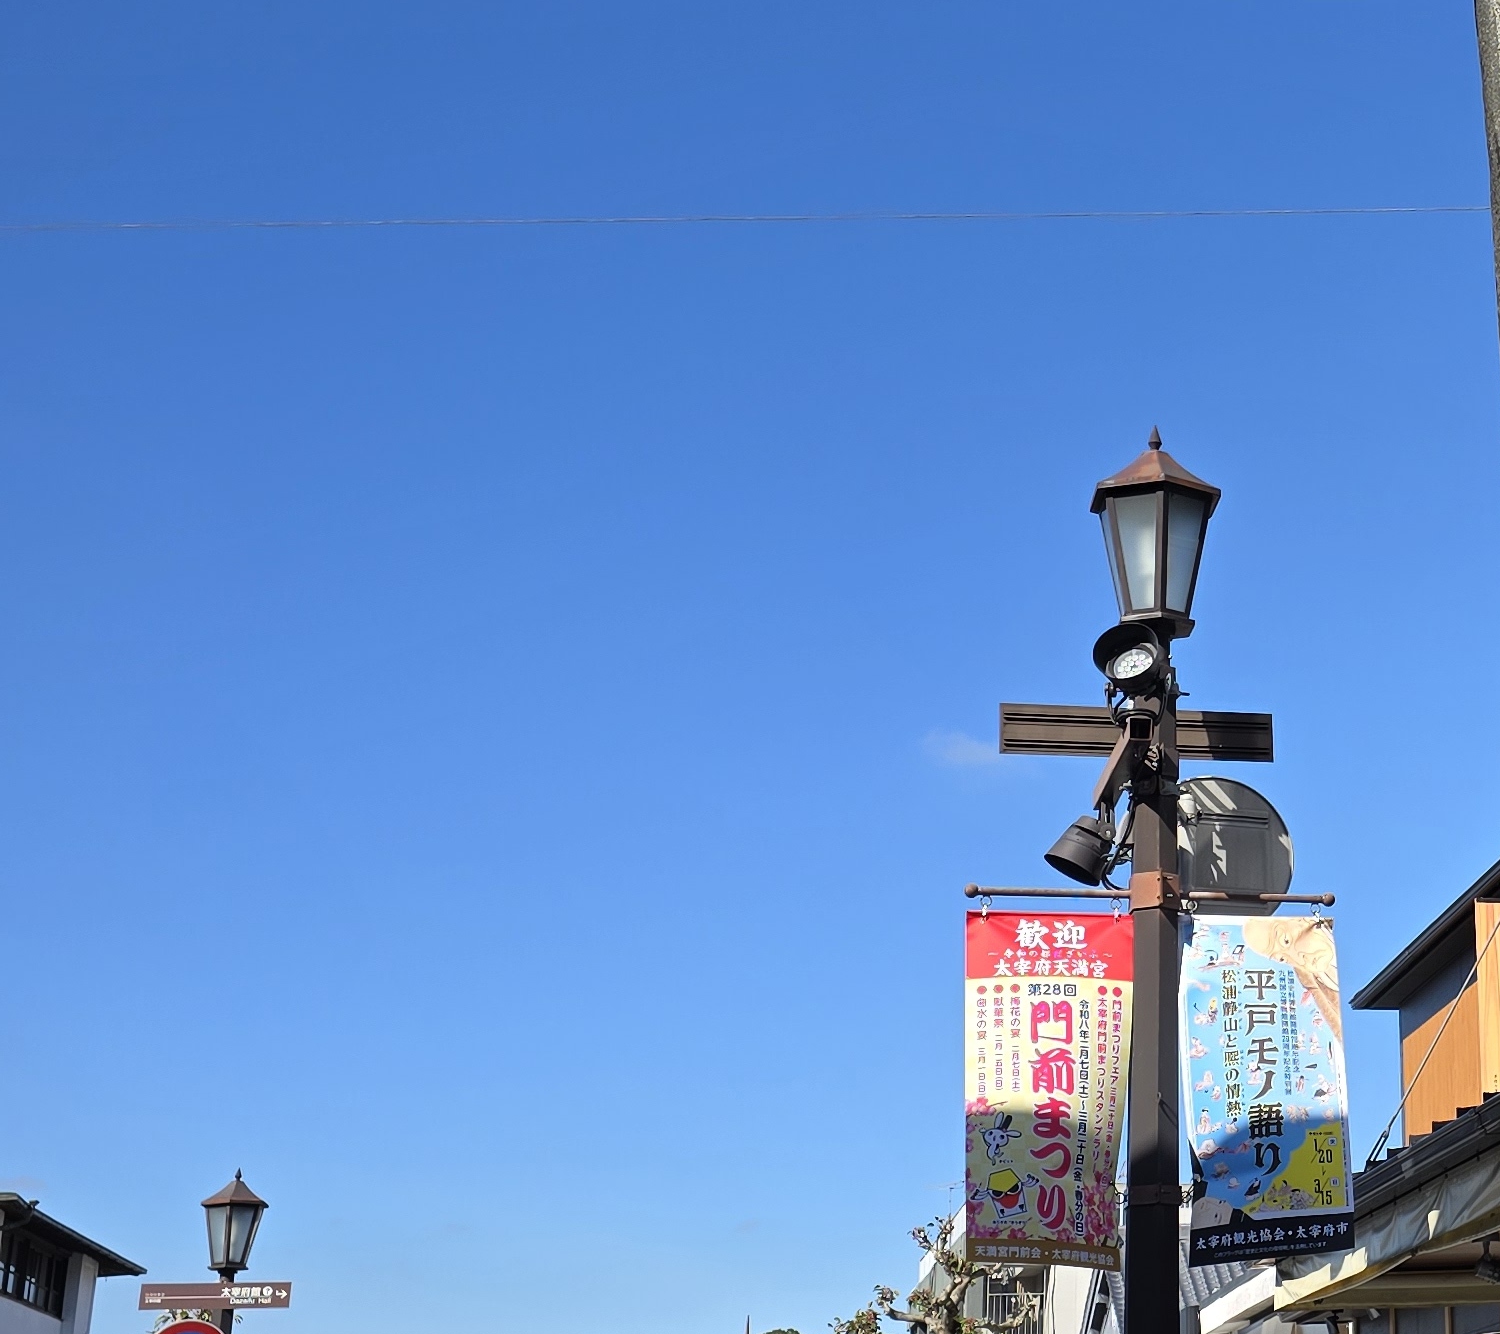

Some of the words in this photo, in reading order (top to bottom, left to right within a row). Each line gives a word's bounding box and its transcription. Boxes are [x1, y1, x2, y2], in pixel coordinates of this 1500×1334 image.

[1014, 919, 1088, 950] 歓迎
[993, 958, 1108, 978] 太宰府天満宮
[1028, 984, 1077, 997] 第28回
[1242, 968, 1285, 1177] 平戸モノ語り
[1028, 999, 1076, 1230] 門前まつり
[1195, 1222, 1349, 1251] 太宰府観光協会・太宰府市
